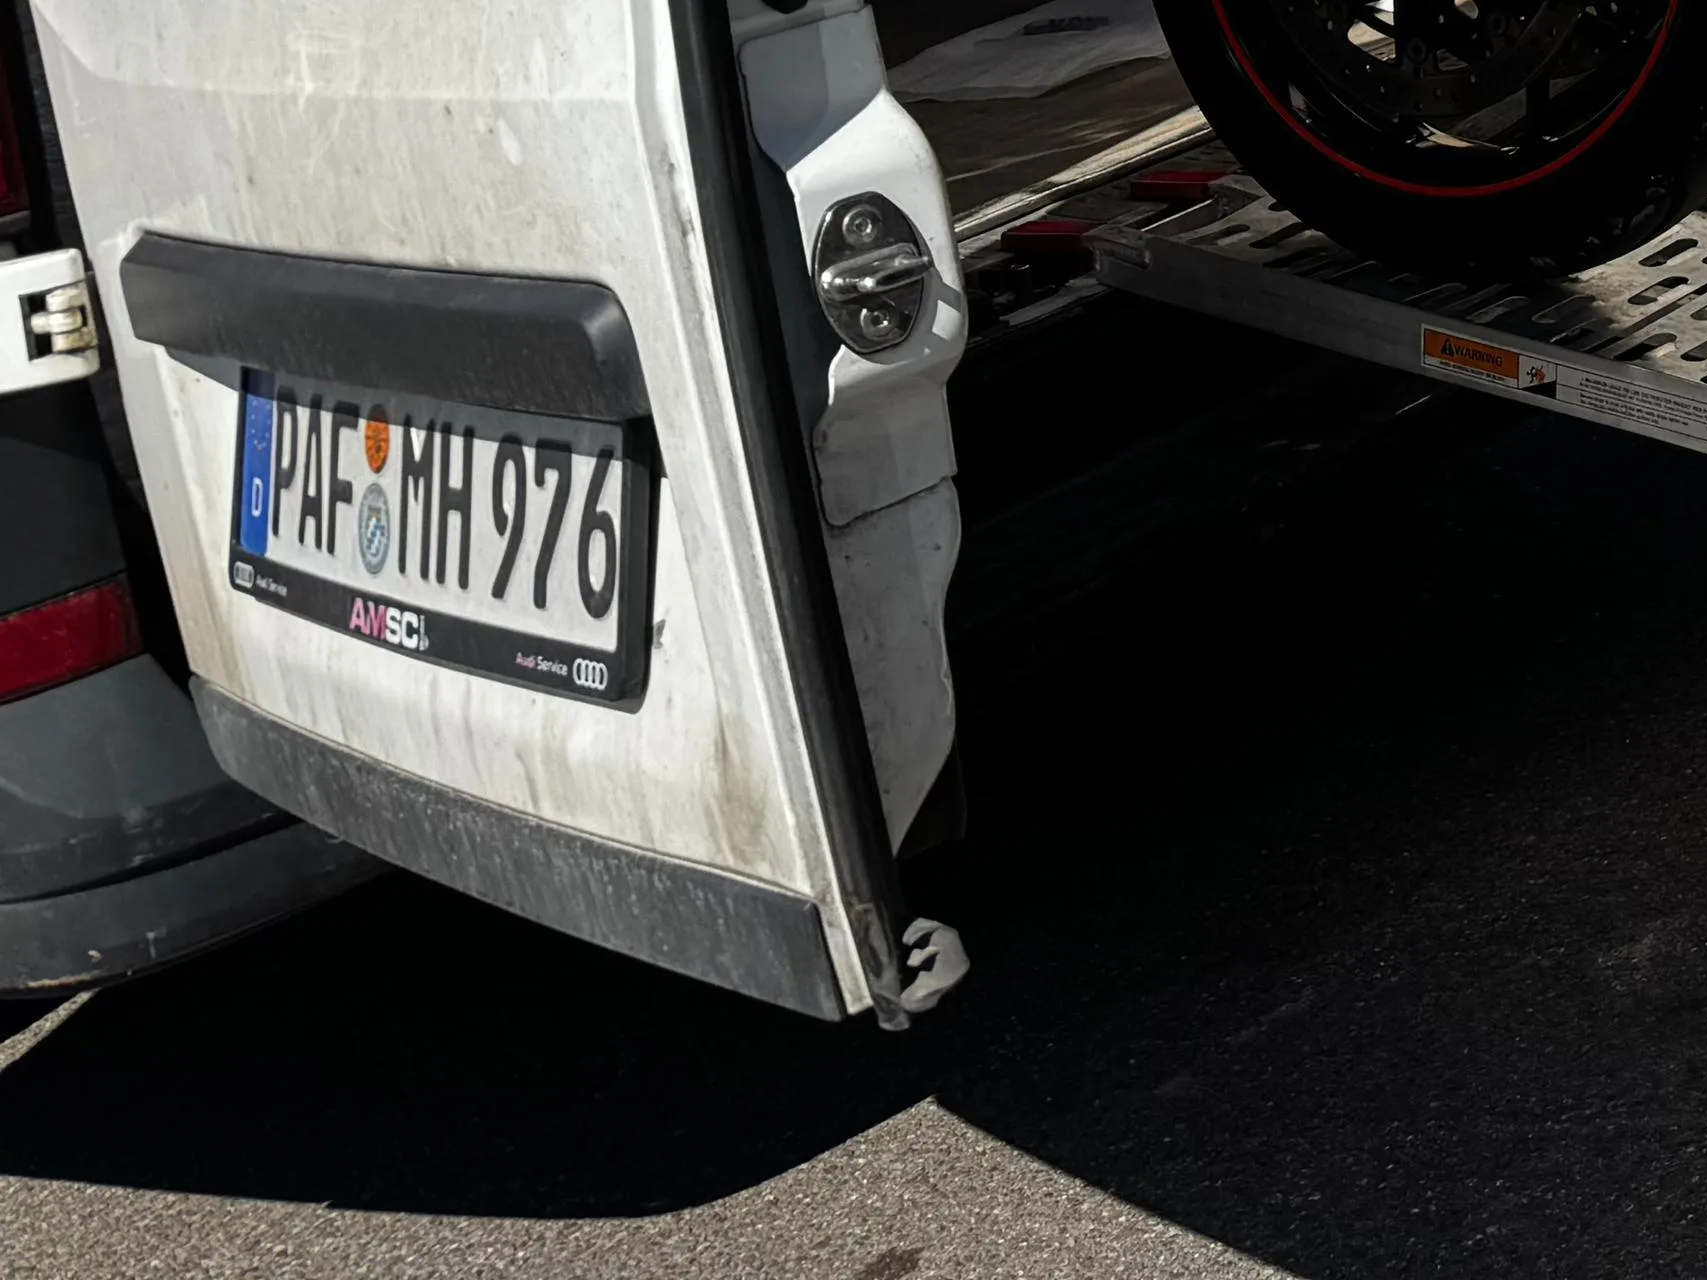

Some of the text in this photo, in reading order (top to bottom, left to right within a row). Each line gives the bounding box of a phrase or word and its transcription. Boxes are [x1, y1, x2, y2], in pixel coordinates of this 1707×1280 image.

[1454, 343, 1504, 367] WARNING
[252, 477, 263, 519] D
[272, 384, 620, 620] PAF MH 976
[516, 651, 568, 677] Audi Service
